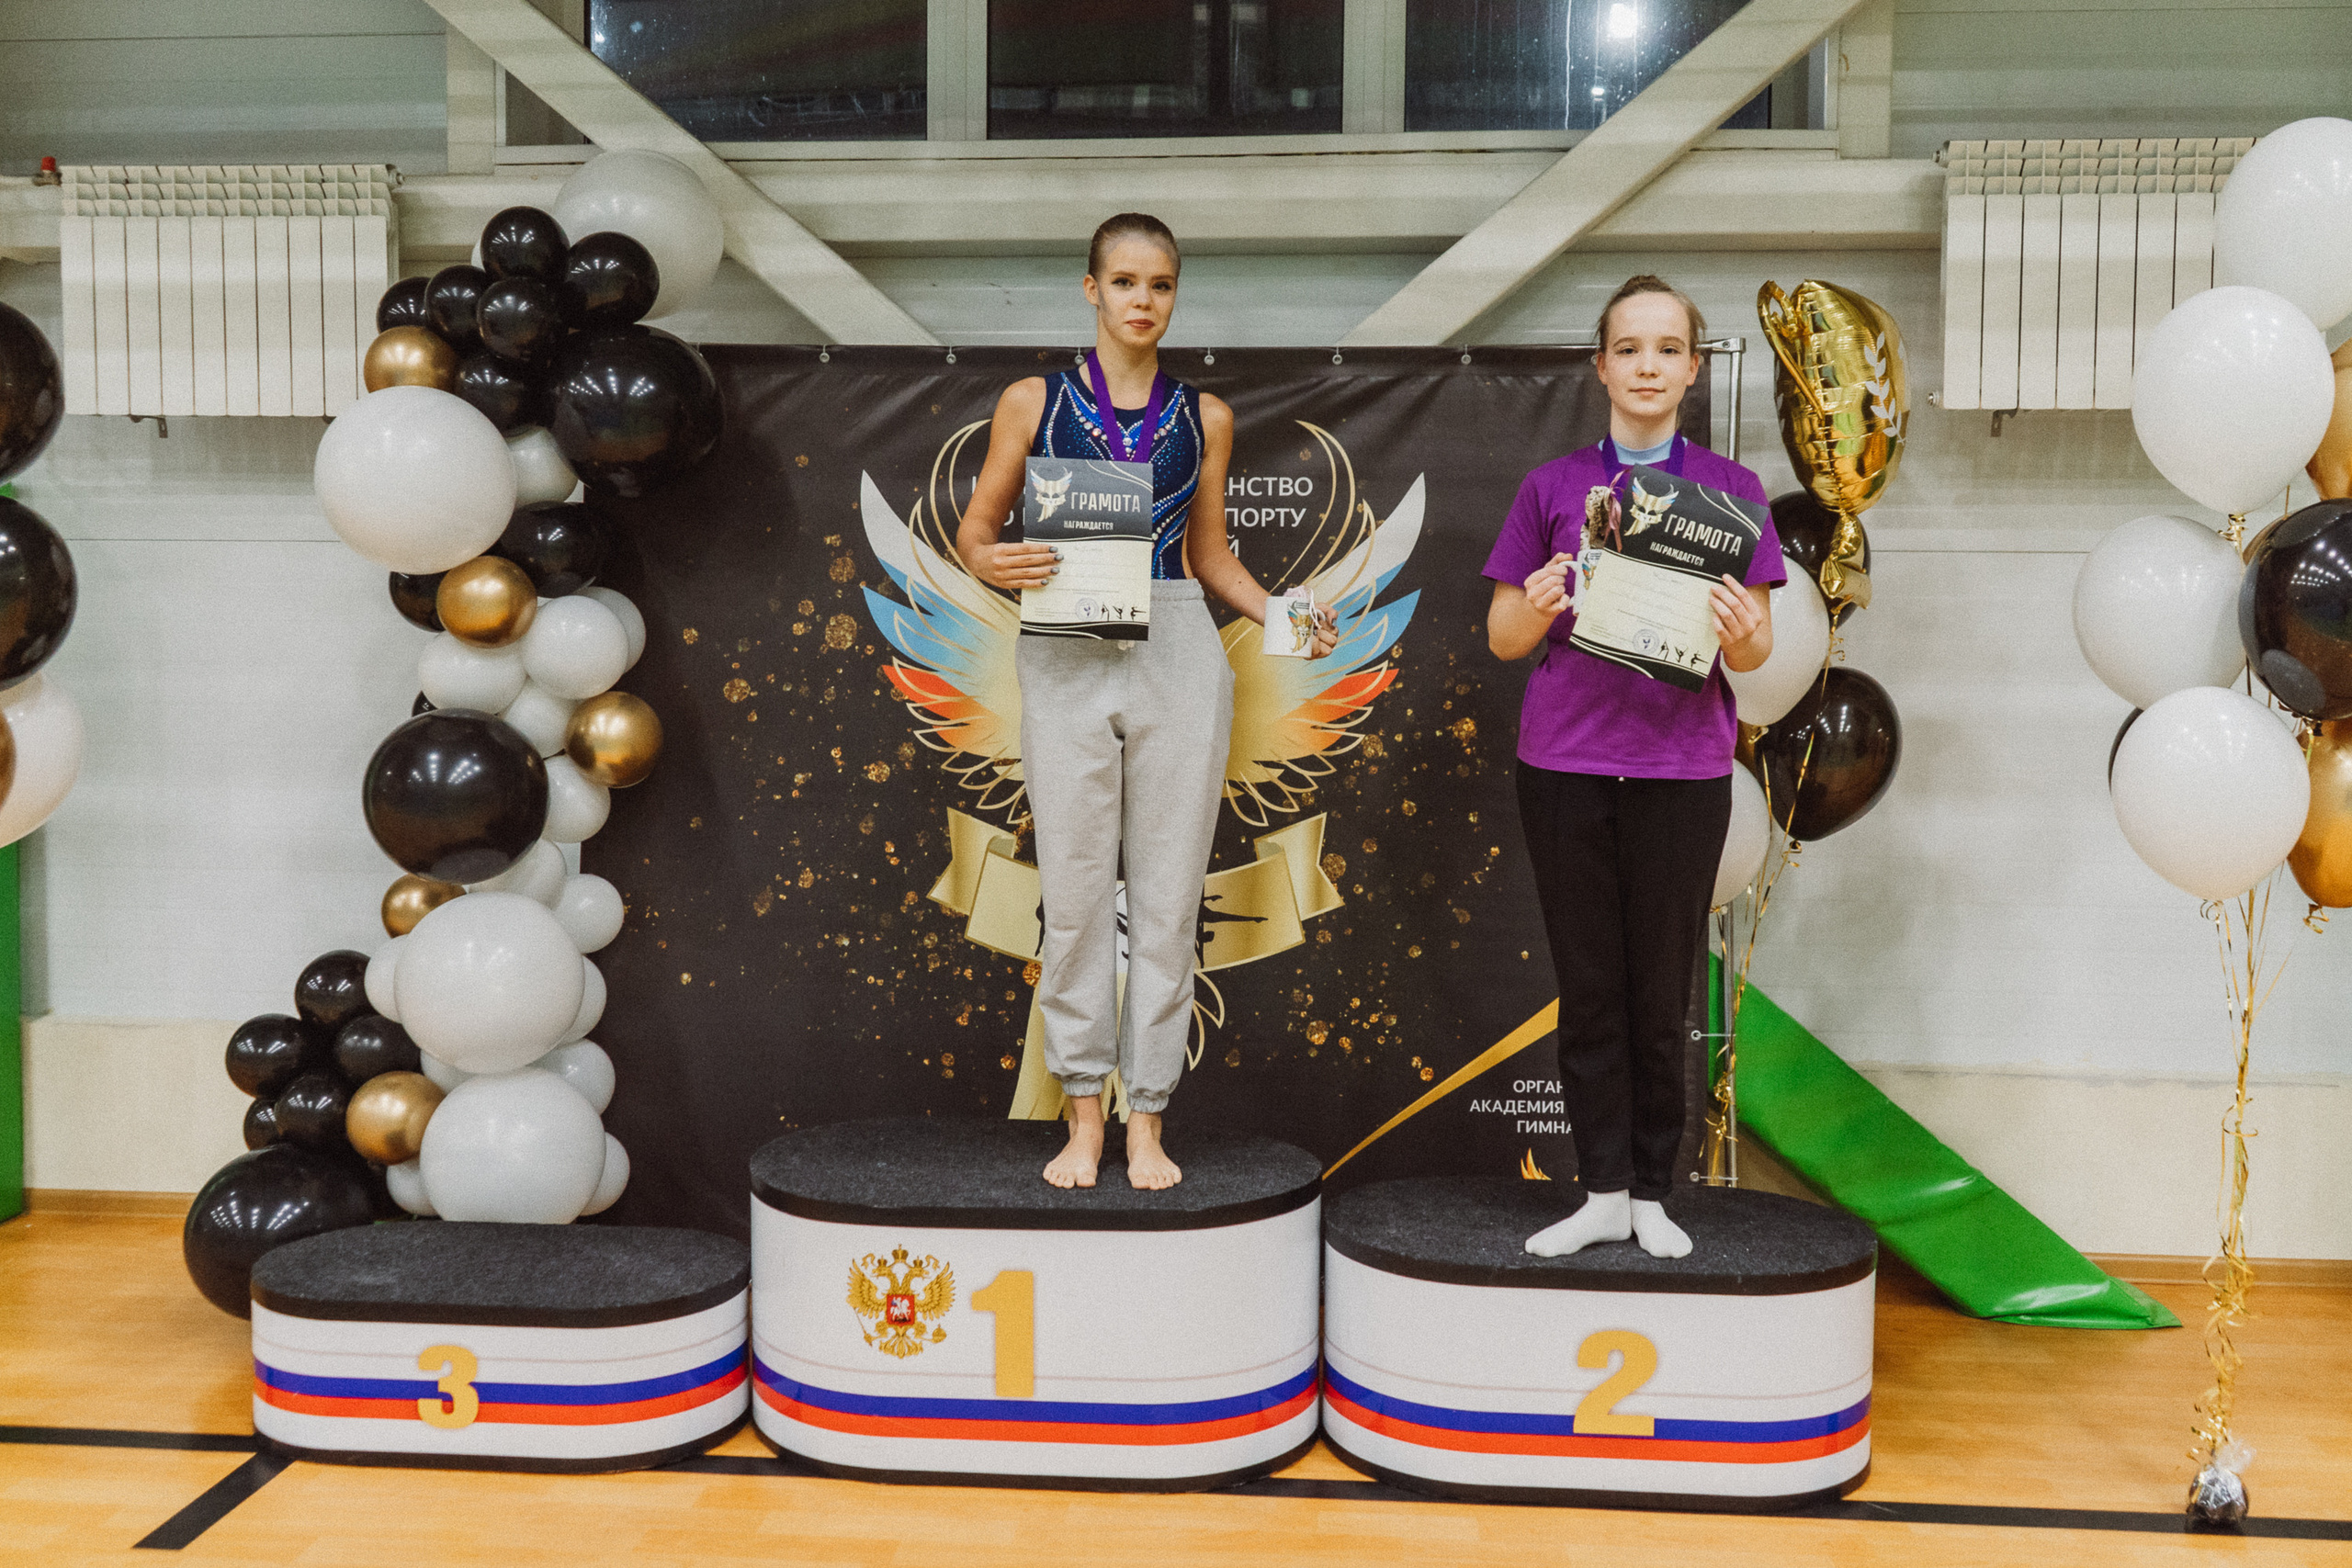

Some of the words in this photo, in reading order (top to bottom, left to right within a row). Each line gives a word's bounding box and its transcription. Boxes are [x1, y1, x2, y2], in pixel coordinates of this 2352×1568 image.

[1224, 477, 1314, 496] НСТВО
[1070, 491, 1140, 513] ГРАМОТА
[1063, 520, 1114, 531] НАГРАЖДАЕТСЯ
[1664, 513, 1743, 557] ГРАМОТА
[1650, 541, 1704, 567] НАГРАЖДАЕТСЯ
[1470, 1100, 1564, 1115] АКАДЕМИЯ
[971, 1270, 1034, 1397] 1
[418, 1344, 479, 1428] 3
[1573, 1330, 1657, 1437] 2
